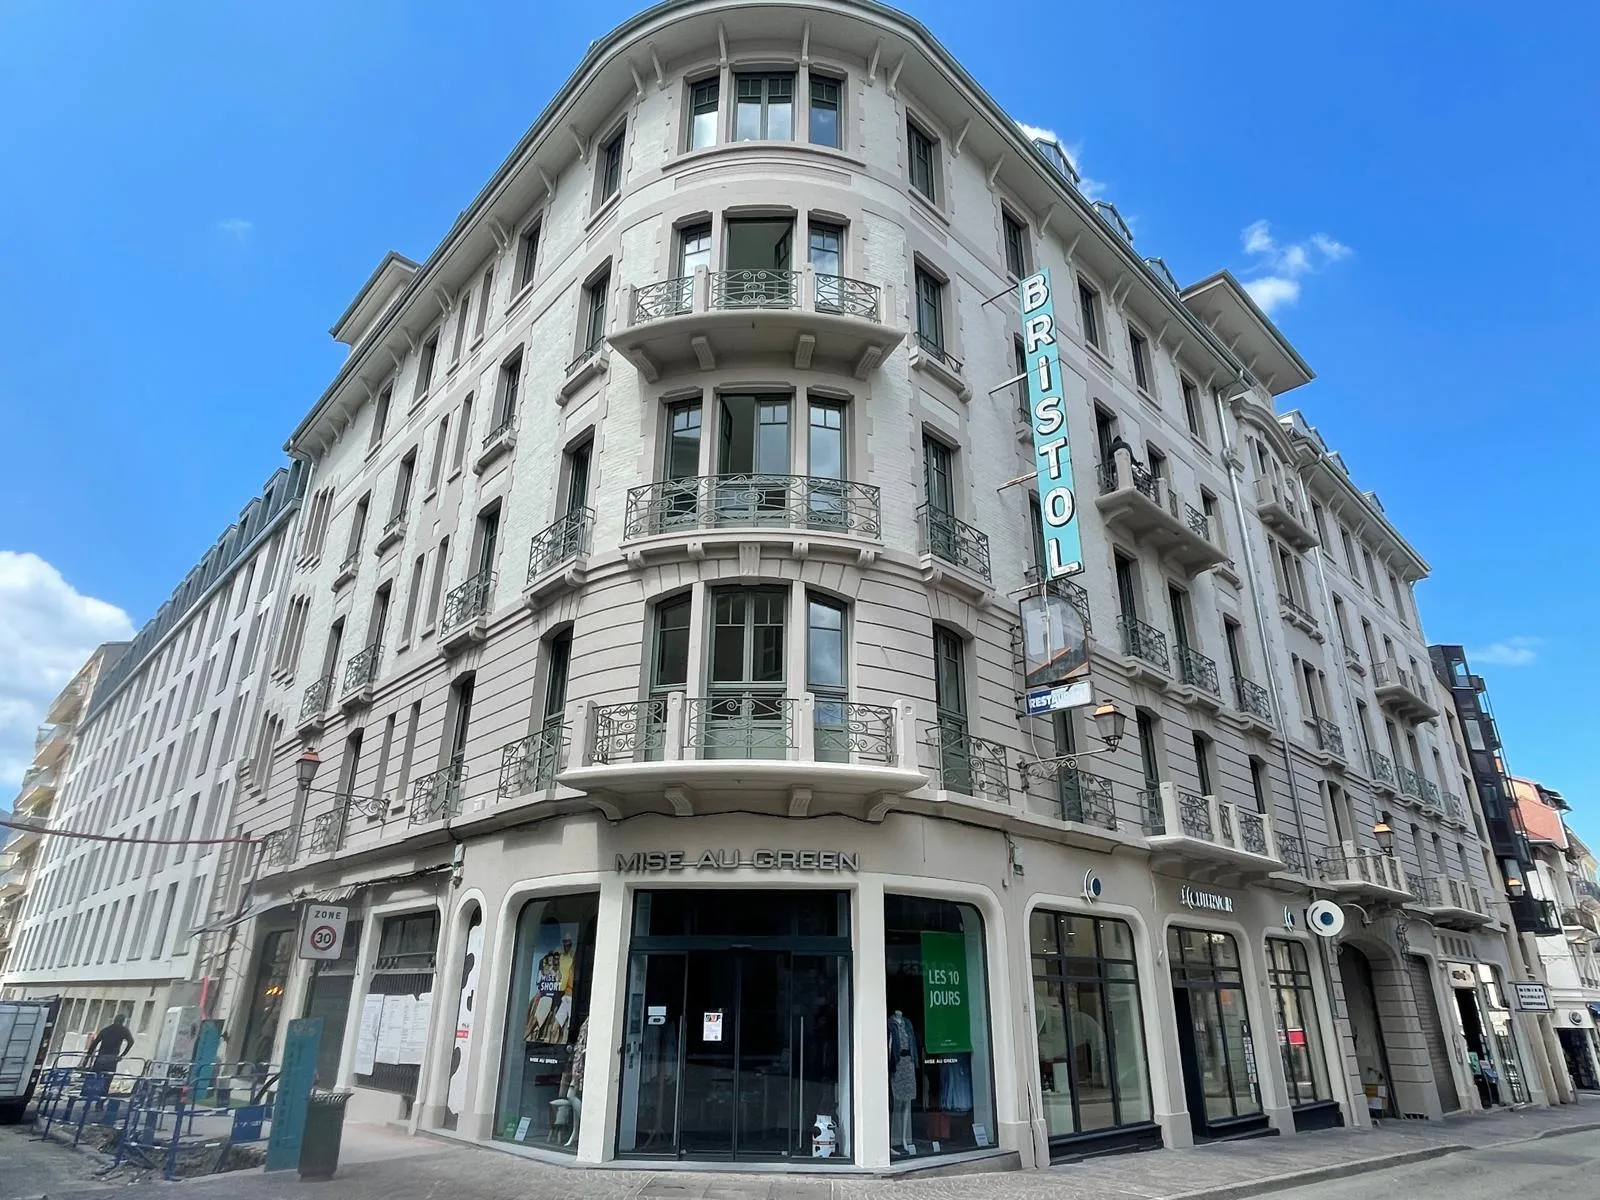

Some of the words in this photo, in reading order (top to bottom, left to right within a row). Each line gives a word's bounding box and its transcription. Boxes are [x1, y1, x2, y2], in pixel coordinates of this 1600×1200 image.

[1020, 273, 1085, 580] BRISTOL
[615, 851, 684, 872] MISE
[697, 849, 739, 868] AU
[752, 849, 860, 872] GREEN
[314, 910, 342, 919] ZONE
[315, 932, 331, 944] 30
[928, 969, 947, 985] LES
[948, 970, 960, 985] 10
[540, 982, 561, 991] SHORT
[929, 990, 960, 1007] JOURS
